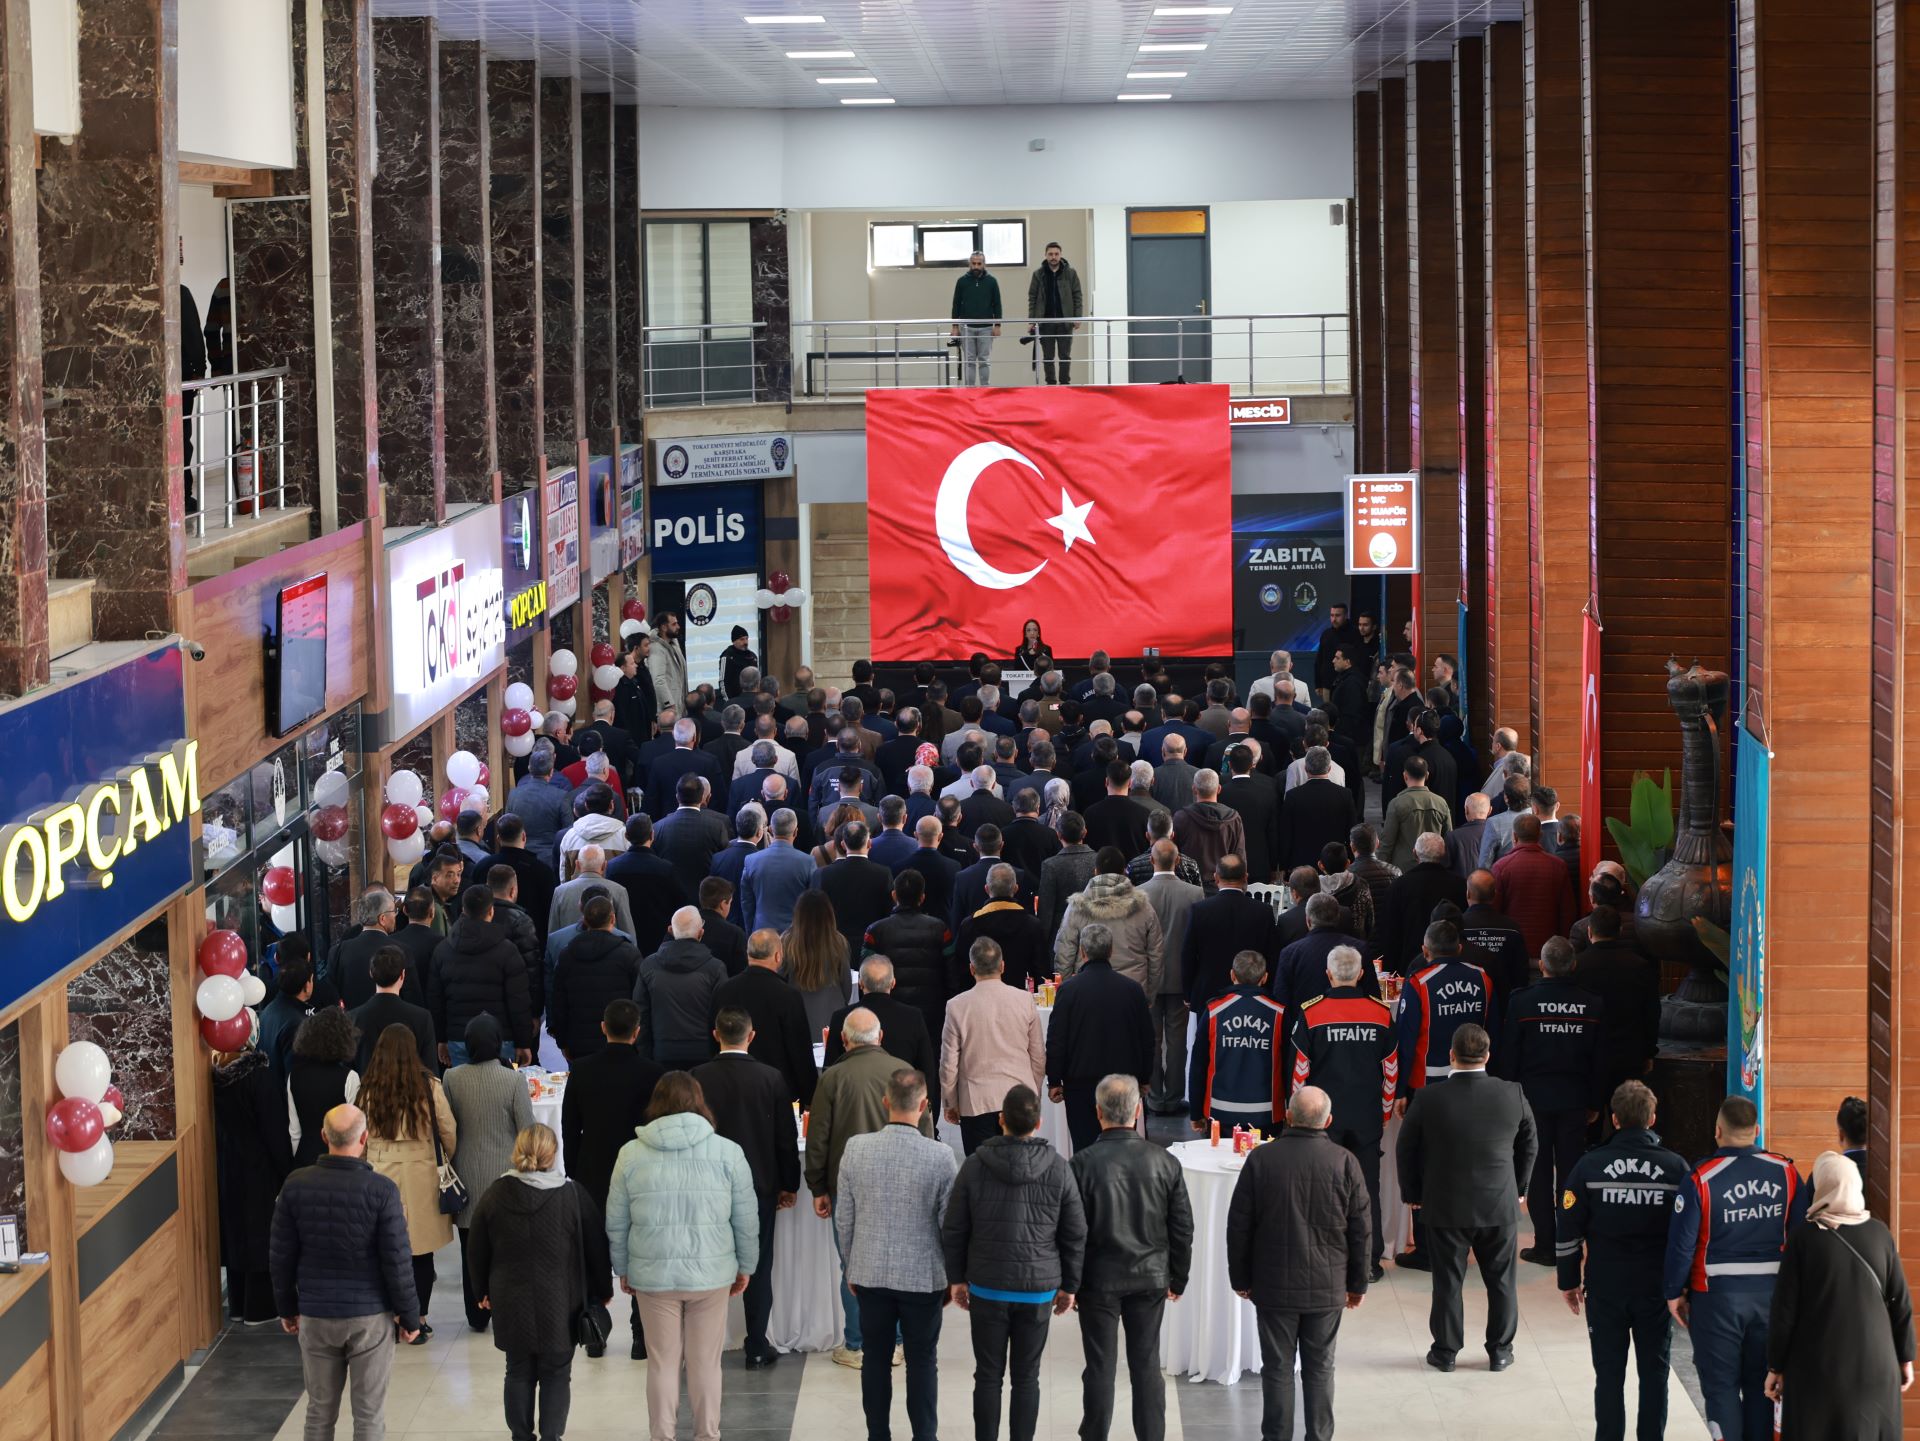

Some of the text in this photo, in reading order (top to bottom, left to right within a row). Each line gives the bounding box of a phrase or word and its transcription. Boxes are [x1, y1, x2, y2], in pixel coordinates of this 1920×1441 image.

[1233, 404, 1284, 418] MESCİD
[691, 466, 770, 479] TERMİNAL POLİS NOKTASI
[1371, 496, 1387, 504] WC
[654, 507, 745, 548] POLİS
[1249, 547, 1326, 563] ZABITA
[511, 580, 547, 631] TOPÇAM
[0, 740, 201, 923] OPÇAM
[1436, 980, 1481, 1000] TOKAT
[1438, 1000, 1482, 1016] İTFAİYE
[1538, 1002, 1587, 1015] TOKAT
[1222, 1014, 1271, 1034] TOKAT
[1539, 1022, 1583, 1034] İTFAİYE
[1222, 1034, 1270, 1050] İTFAİYE
[1326, 1025, 1377, 1042] İTFAİYE
[1603, 1157, 1665, 1180] TOKAT
[1723, 1179, 1782, 1205] TOKAT
[1723, 1202, 1783, 1224] İTFAİYE
